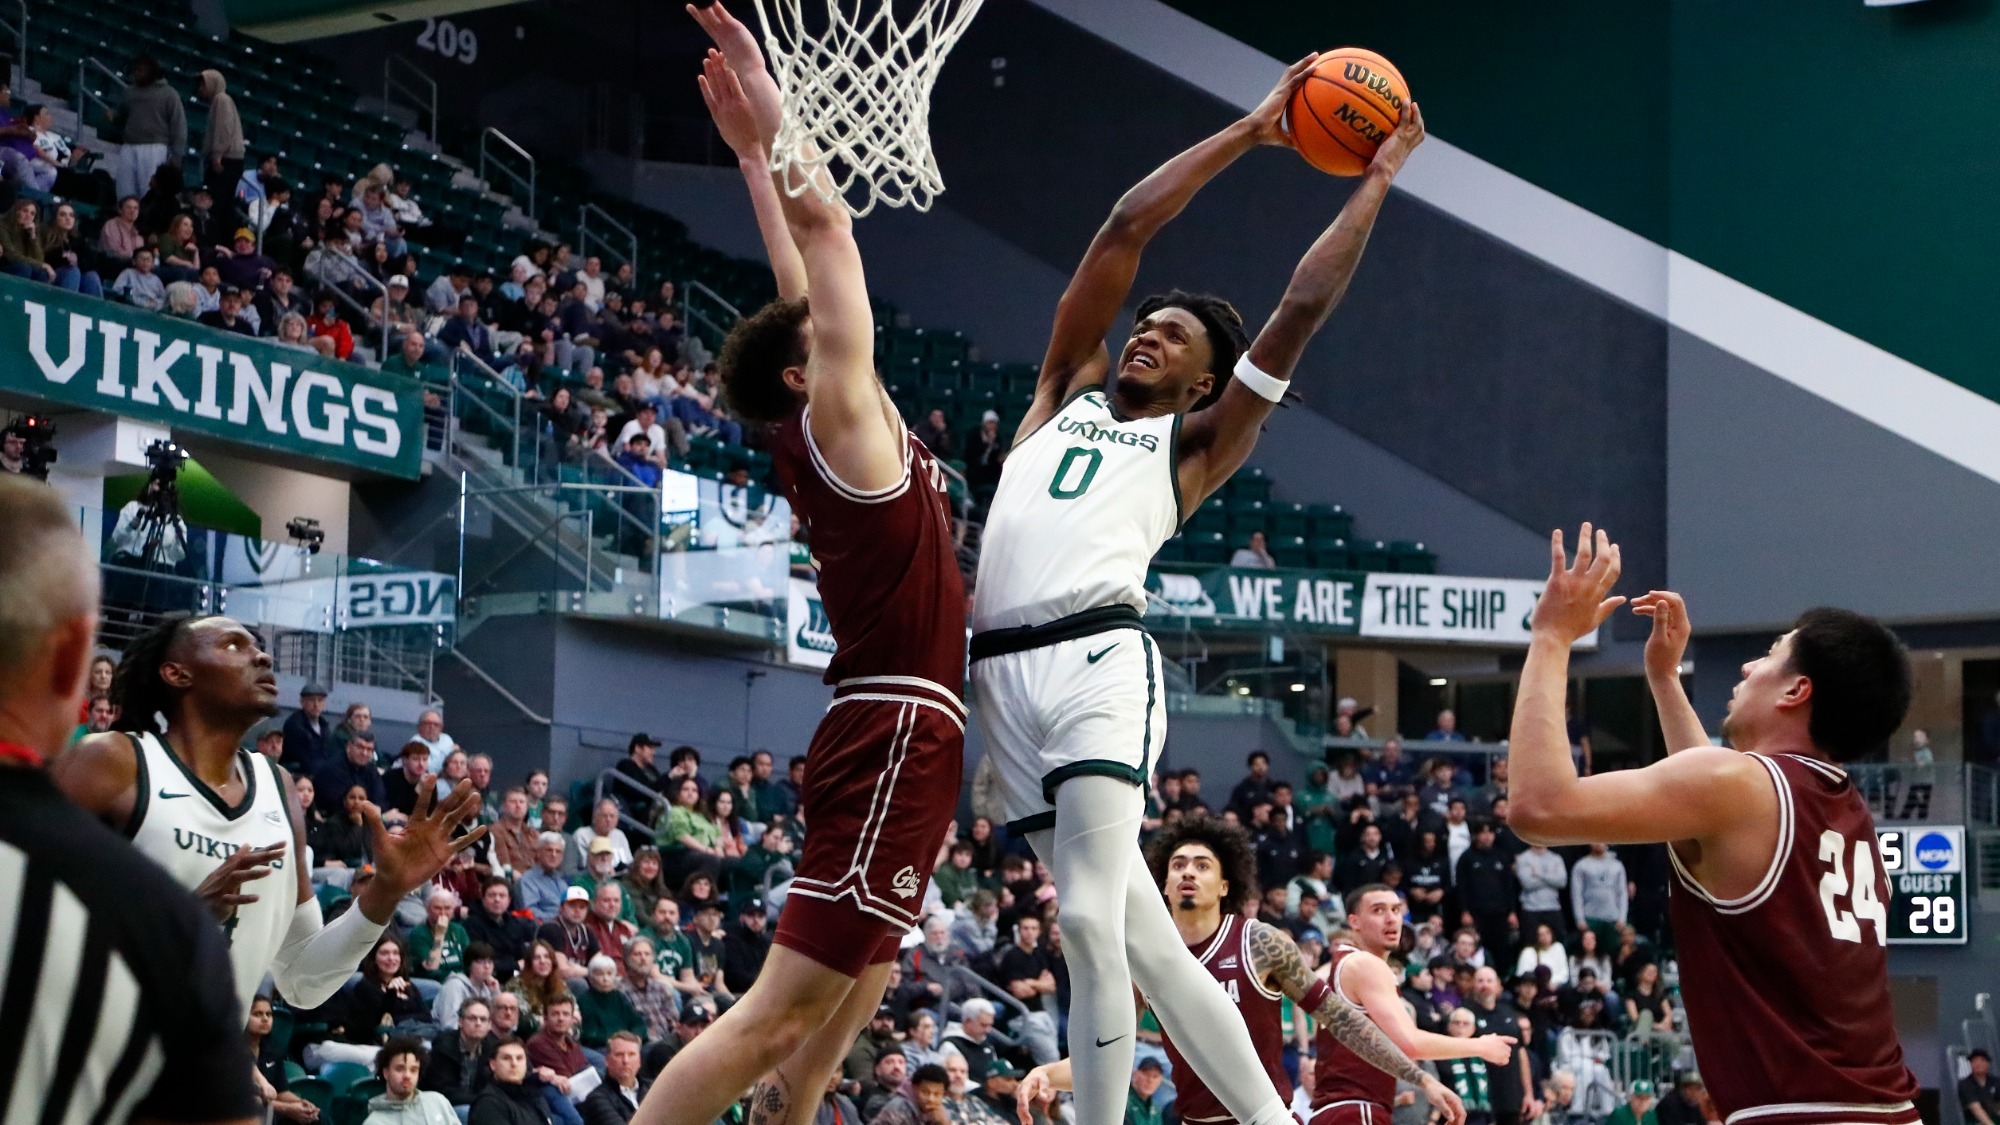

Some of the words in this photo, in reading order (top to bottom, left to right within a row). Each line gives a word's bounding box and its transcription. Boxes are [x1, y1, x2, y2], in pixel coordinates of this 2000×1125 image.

[416, 17, 478, 65] 209
[1343, 61, 1403, 114] Wilso
[24, 300, 401, 459] VIKINGS
[1048, 446, 1104, 500] 0
[1229, 575, 1285, 620] WE
[1294, 579, 1354, 625] ARE
[1376, 585, 1430, 627] THE
[1443, 588, 1506, 629] SHIP
[1818, 829, 1887, 947] 24
[1900, 874, 1953, 893] GUEST
[1909, 896, 1955, 934] 28
